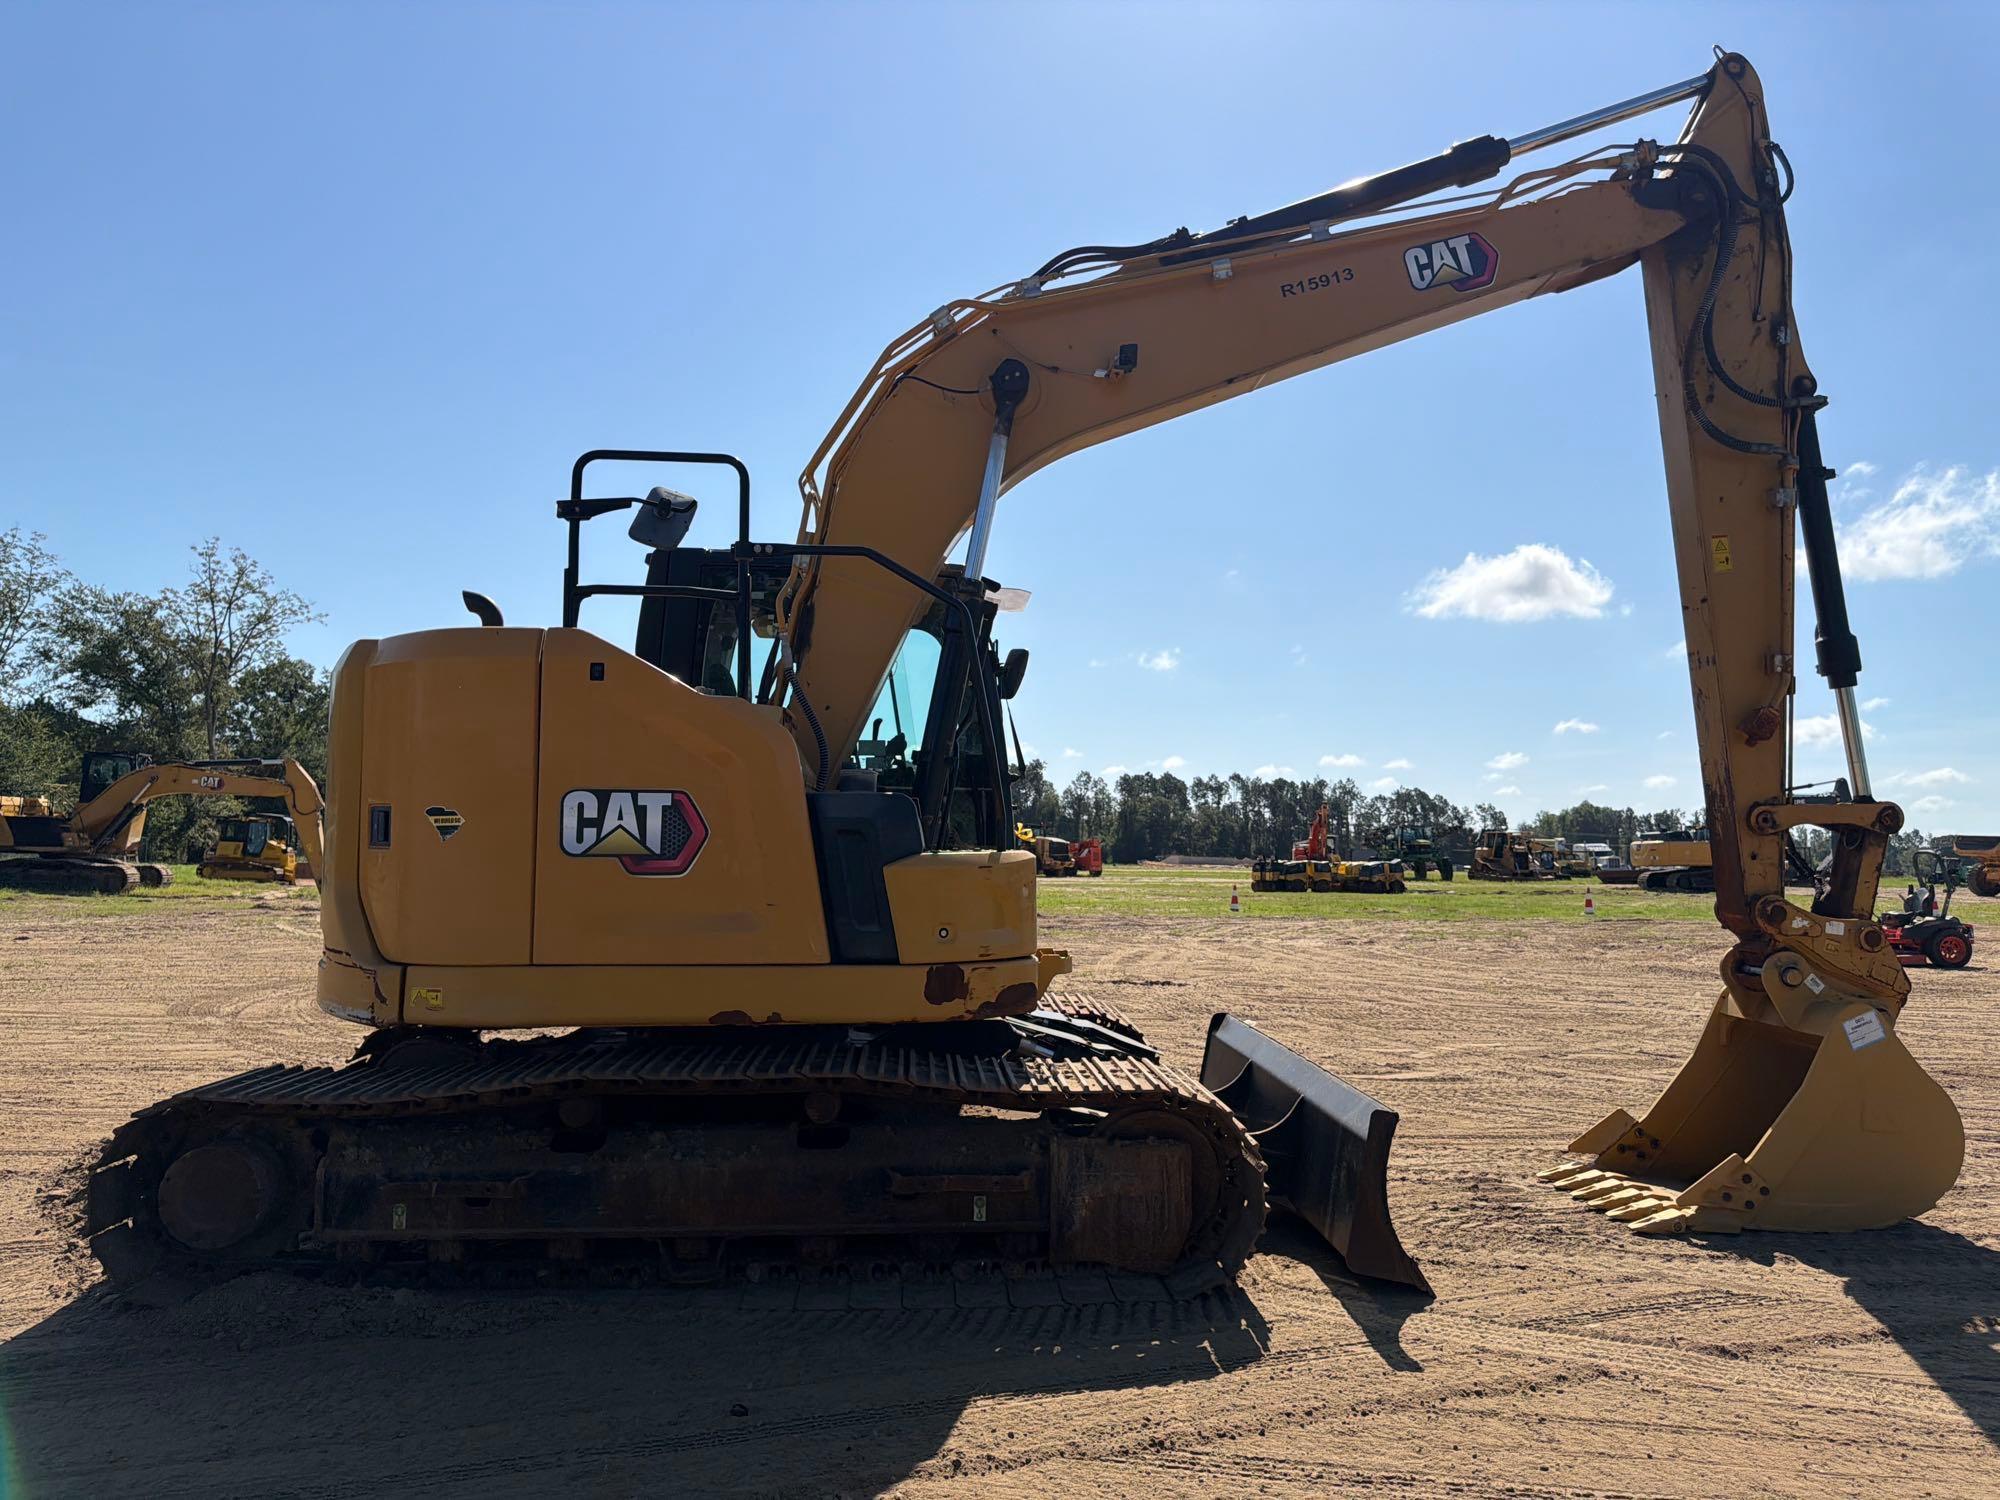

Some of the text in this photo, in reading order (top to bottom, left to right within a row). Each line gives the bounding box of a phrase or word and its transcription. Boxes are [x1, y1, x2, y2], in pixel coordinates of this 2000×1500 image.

[1405, 234, 1473, 289] CAT
[1280, 268, 1354, 298] R15913
[201, 776, 219, 788] CAT
[563, 790, 672, 855] CAT
